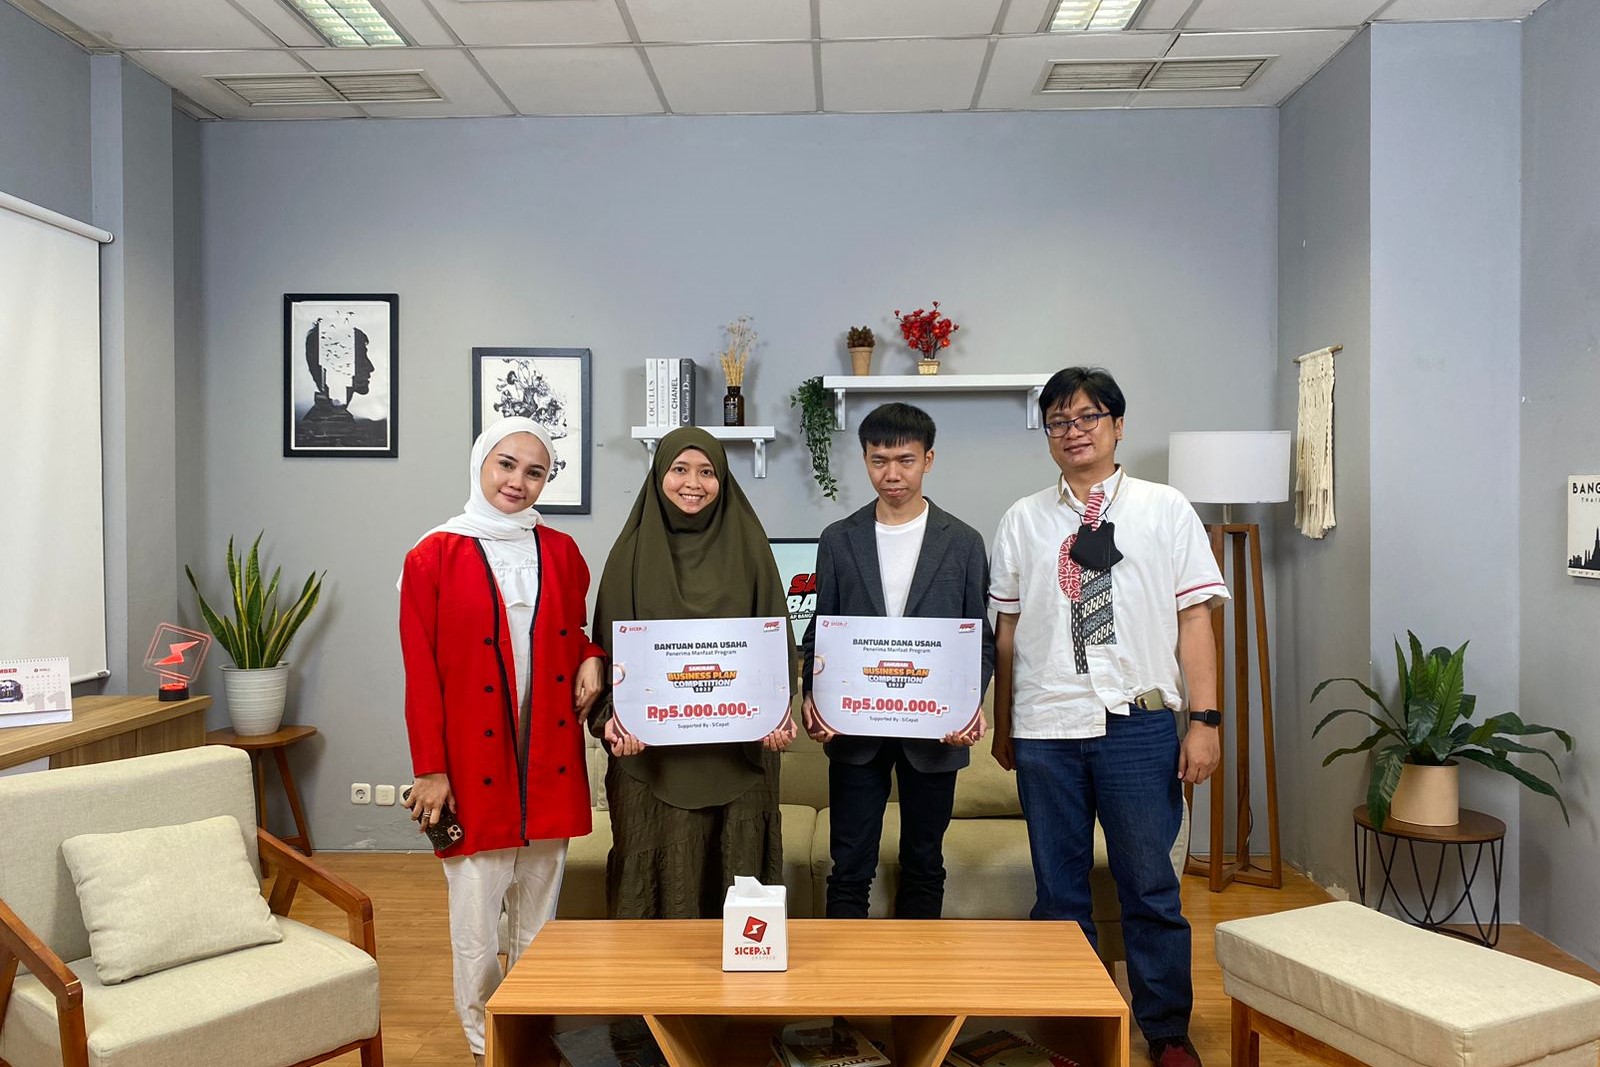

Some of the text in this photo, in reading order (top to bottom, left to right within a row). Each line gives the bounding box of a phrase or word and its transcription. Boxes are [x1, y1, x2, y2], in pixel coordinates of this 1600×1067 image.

[671, 377, 679, 409] CHANEL
[682, 391, 690, 423] Christian
[654, 640, 748, 651] BANTUAN DANA USAHA
[852, 638, 942, 648] BANTUAN DANA USAHA
[714, 649, 737, 657] Program
[908, 647, 931, 655] Program
[667, 670, 737, 681] BUSINESS PLAN
[863, 667, 930, 678] BUSINESS PLAN
[673, 679, 732, 689] COMPETITION
[868, 675, 923, 684] COMPETITION
[26, 691, 66, 710] 11
[841, 697, 948, 714] Rp5.000.000,-
[647, 702, 758, 722] Rp5.000.000,-
[869, 715, 892, 723] Supported
[677, 722, 702, 730] Supported
[735, 947, 771, 955] SICEPAT
